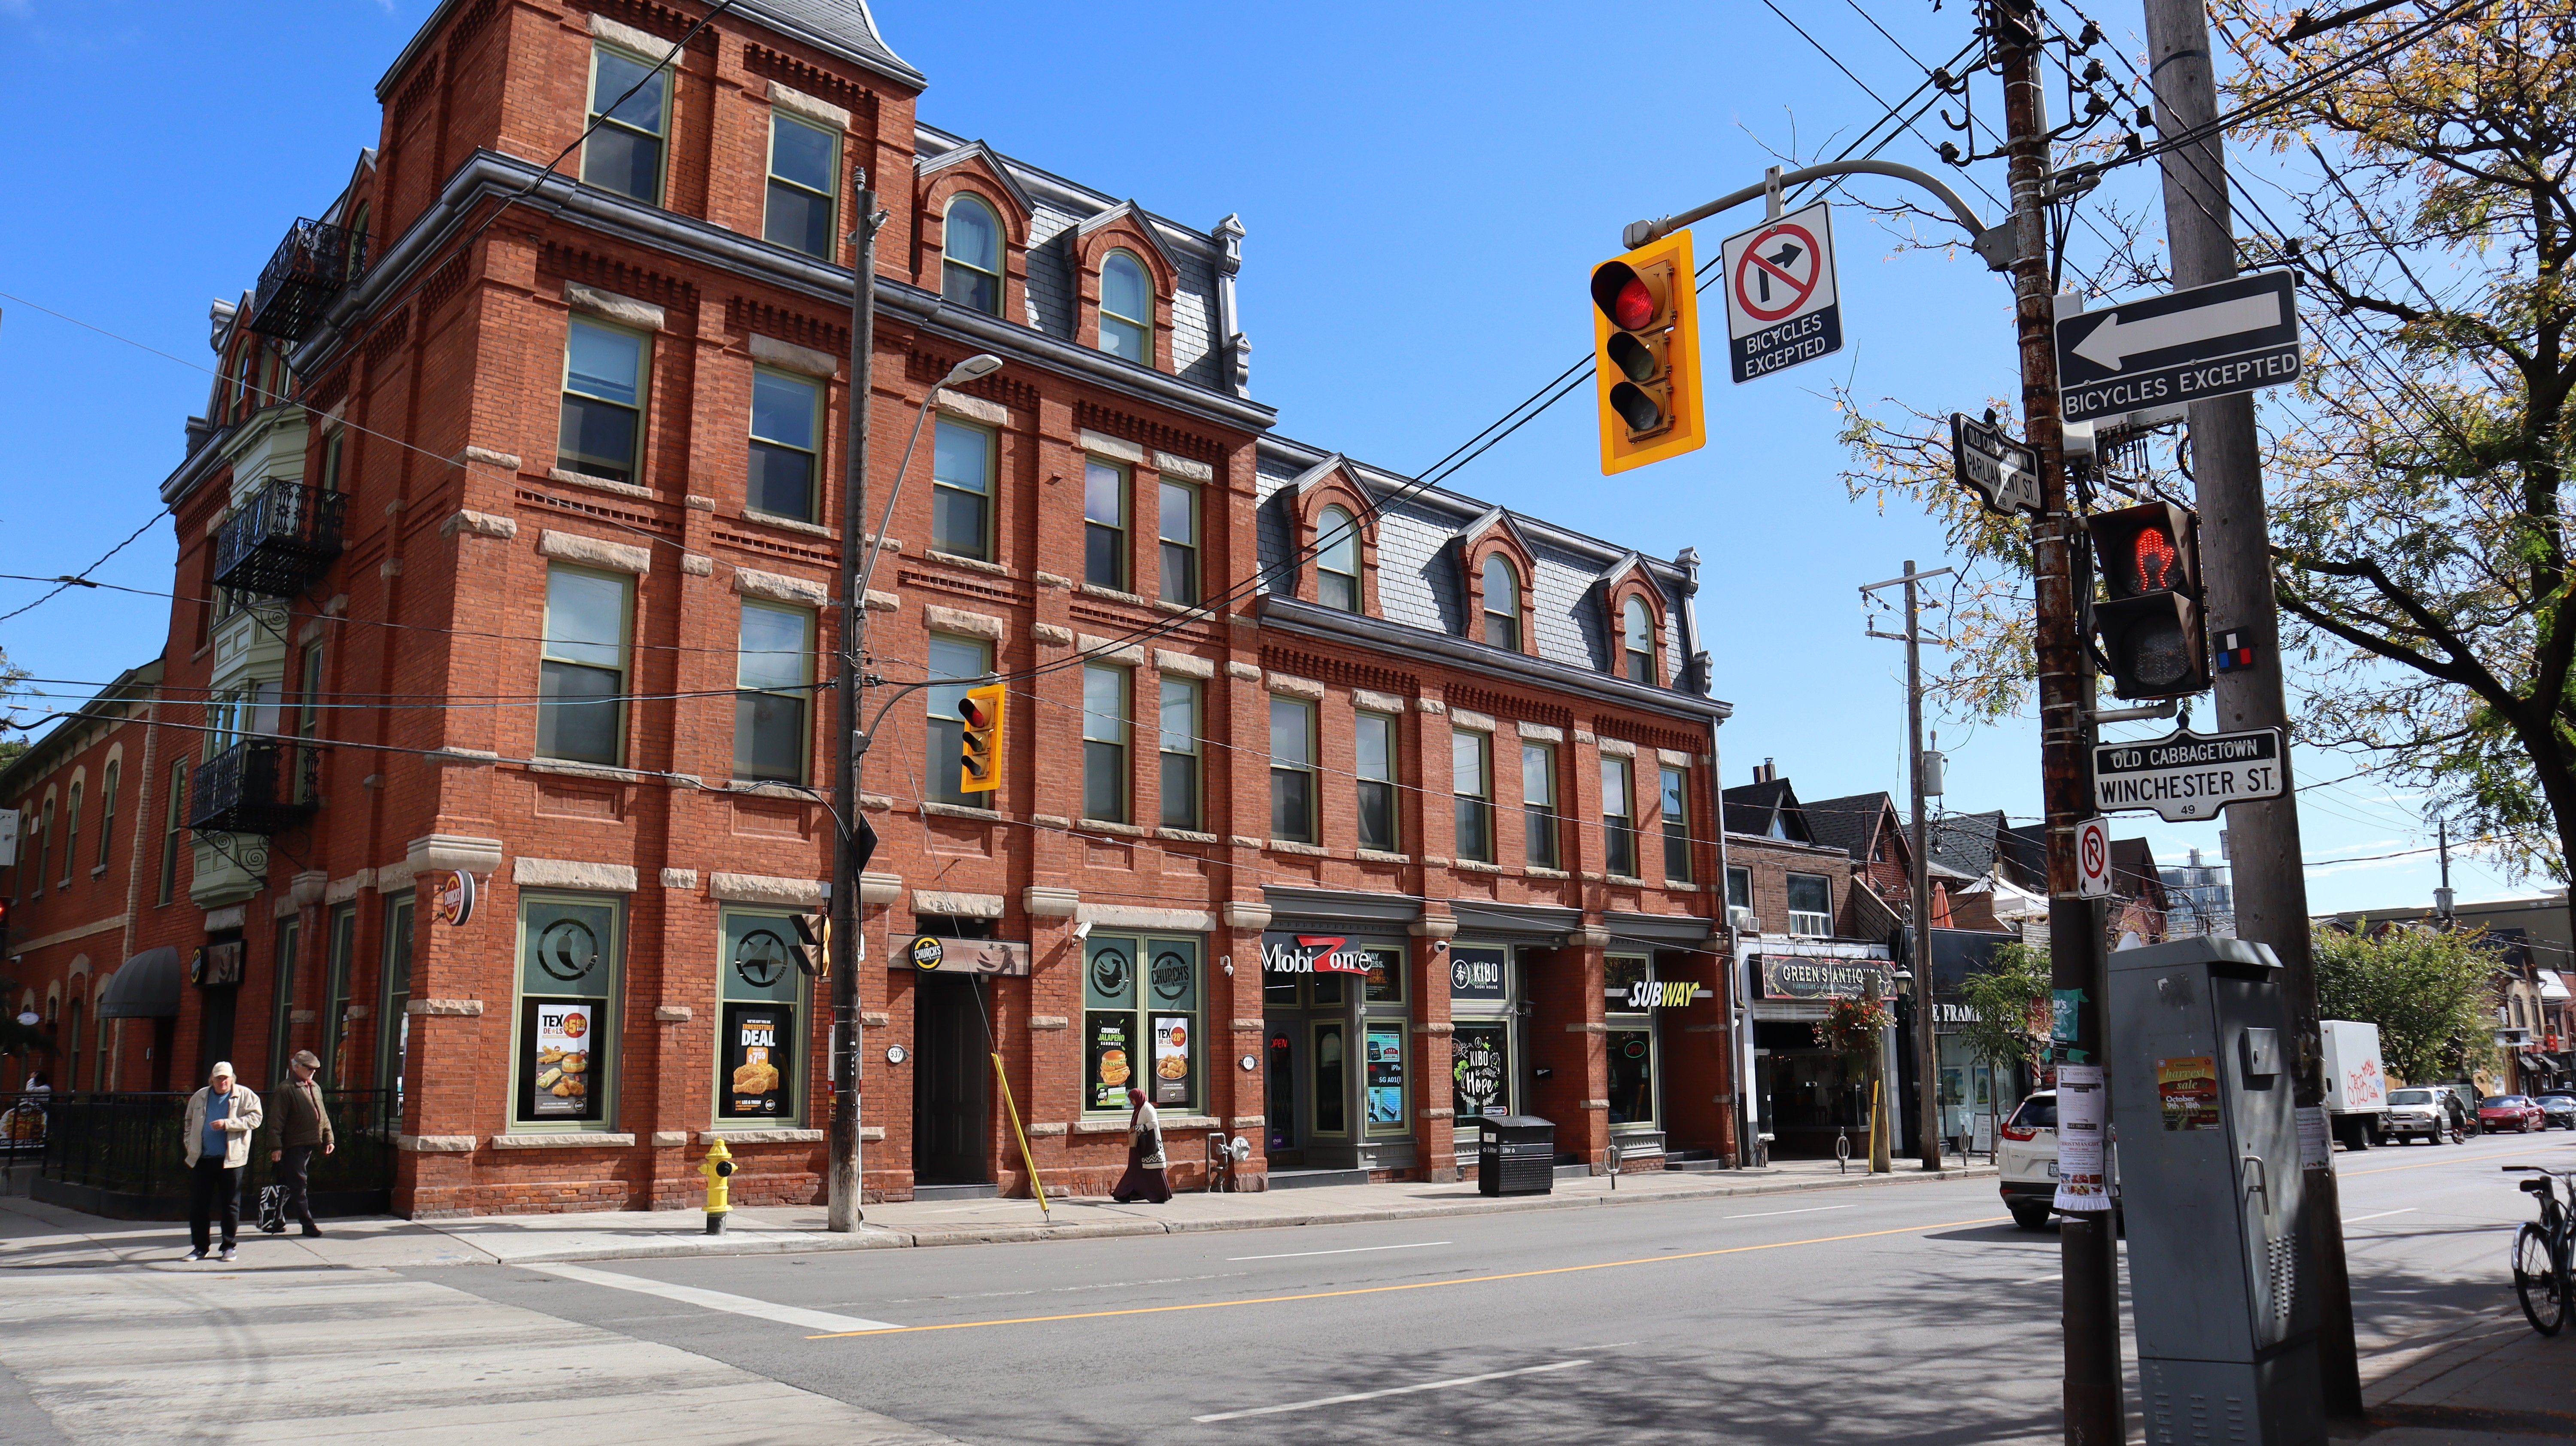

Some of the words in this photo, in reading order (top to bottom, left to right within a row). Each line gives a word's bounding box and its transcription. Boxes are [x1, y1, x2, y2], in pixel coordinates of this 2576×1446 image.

[1746, 314, 1822, 355] BICYCLES
[1745, 336, 1826, 377] EXCEPTED
[2066, 378, 2168, 415] BICYCLES
[2179, 353, 2297, 392] EXCEPTED
[1968, 428, 1981, 447] OLD
[1983, 435, 2029, 470] CABBAGETOWN
[1966, 452, 2019, 495] PARLIAMENT
[2023, 478, 2037, 502] ST.
[1998, 495, 2007, 506] 518
[2113, 750, 2142, 769] OLD
[2150, 739, 2257, 766] CABBAGETOWN
[2100, 771, 2235, 804] WINCHESTER
[2247, 767, 2275, 792] ST.
[2181, 805, 2195, 814] 49
[914, 945, 941, 960] CHURCH'S
[1261, 935, 1372, 975] MobiZone
[585, 958, 596, 972] BOLD
[775, 966, 787, 981] TEXAS
[1473, 962, 1498, 983] KIBO
[1151, 966, 1189, 986] CHURCH'S
[1783, 966, 1827, 982] GREEN'S
[1832, 968, 1882, 985] ANTIQS
[1628, 981, 1700, 1008] SUBWAY
[542, 1014, 564, 1027] TEX
[741, 1030, 776, 1047] DEAL
[1157, 1027, 1171, 1038] TEX
[1470, 1051, 1488, 1066] KIBO
[1627, 1045, 1643, 1054] OPEN
[1475, 1068, 1480, 1076] is
[2166, 1068, 2205, 1078] harvest
[1466, 1072, 1494, 1096] Hope
[2177, 1079, 2198, 1090] sale
